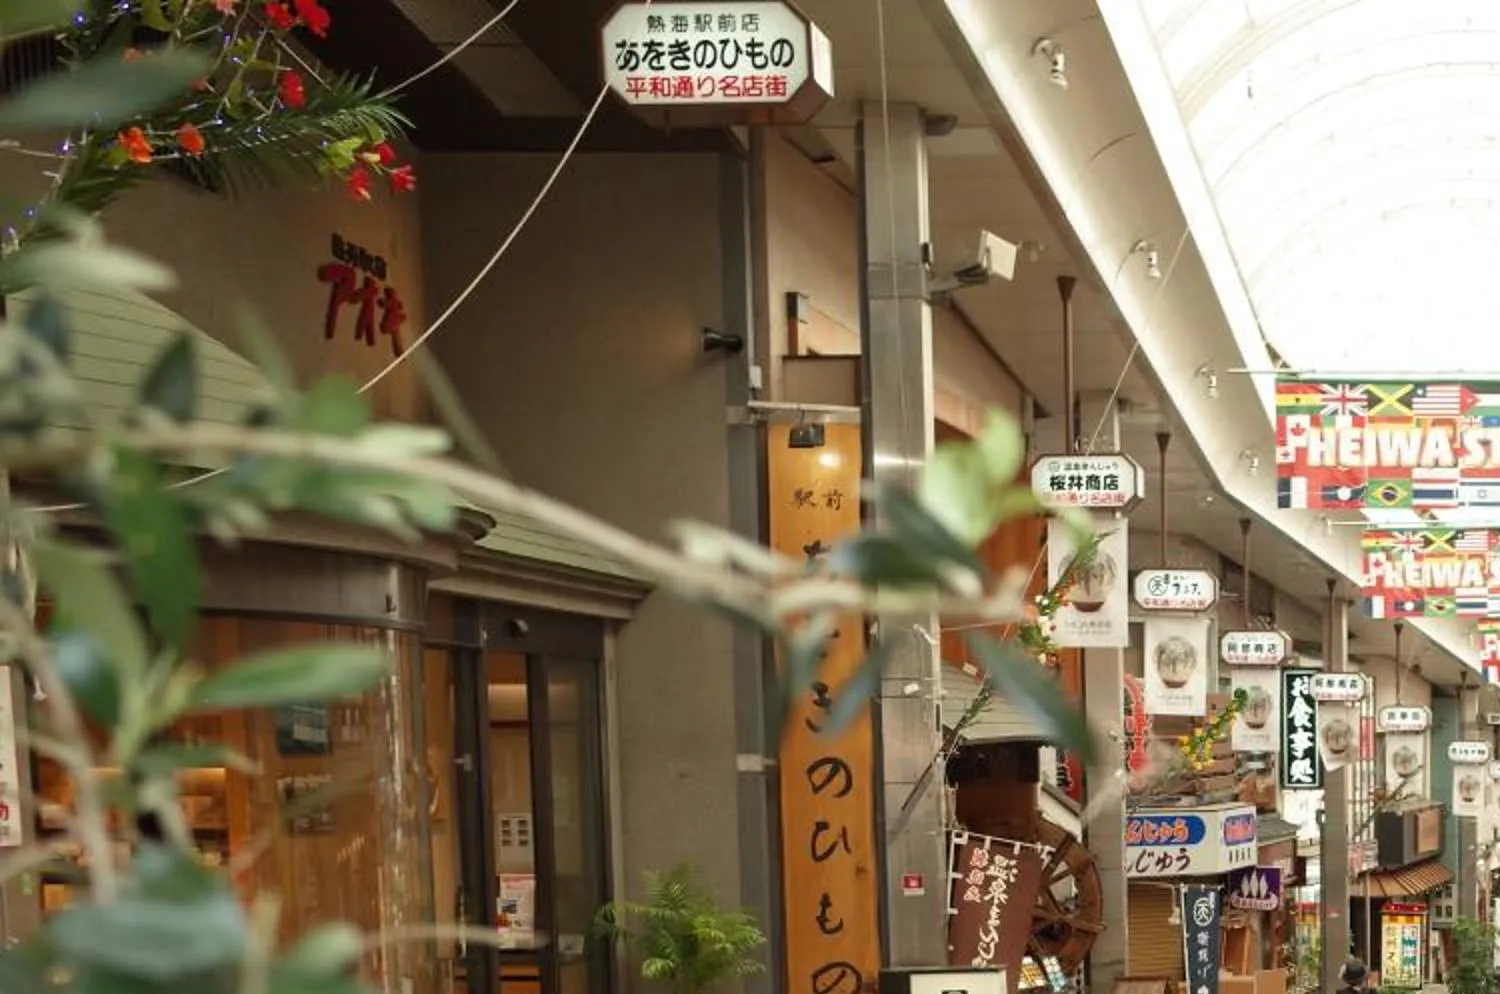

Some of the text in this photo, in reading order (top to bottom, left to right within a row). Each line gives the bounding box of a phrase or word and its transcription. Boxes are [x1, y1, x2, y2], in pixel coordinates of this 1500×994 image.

[647, 13, 760, 33] 熱海駅前店
[615, 38, 795, 72] あをきのひもの
[625, 75, 788, 98] 平和通り名店街
[1307, 425, 1454, 468] HEIWA
[1049, 474, 1119, 491] 桜井商店
[1385, 557, 1483, 587] HEIWA
[1288, 676, 1314, 782] お食事処
